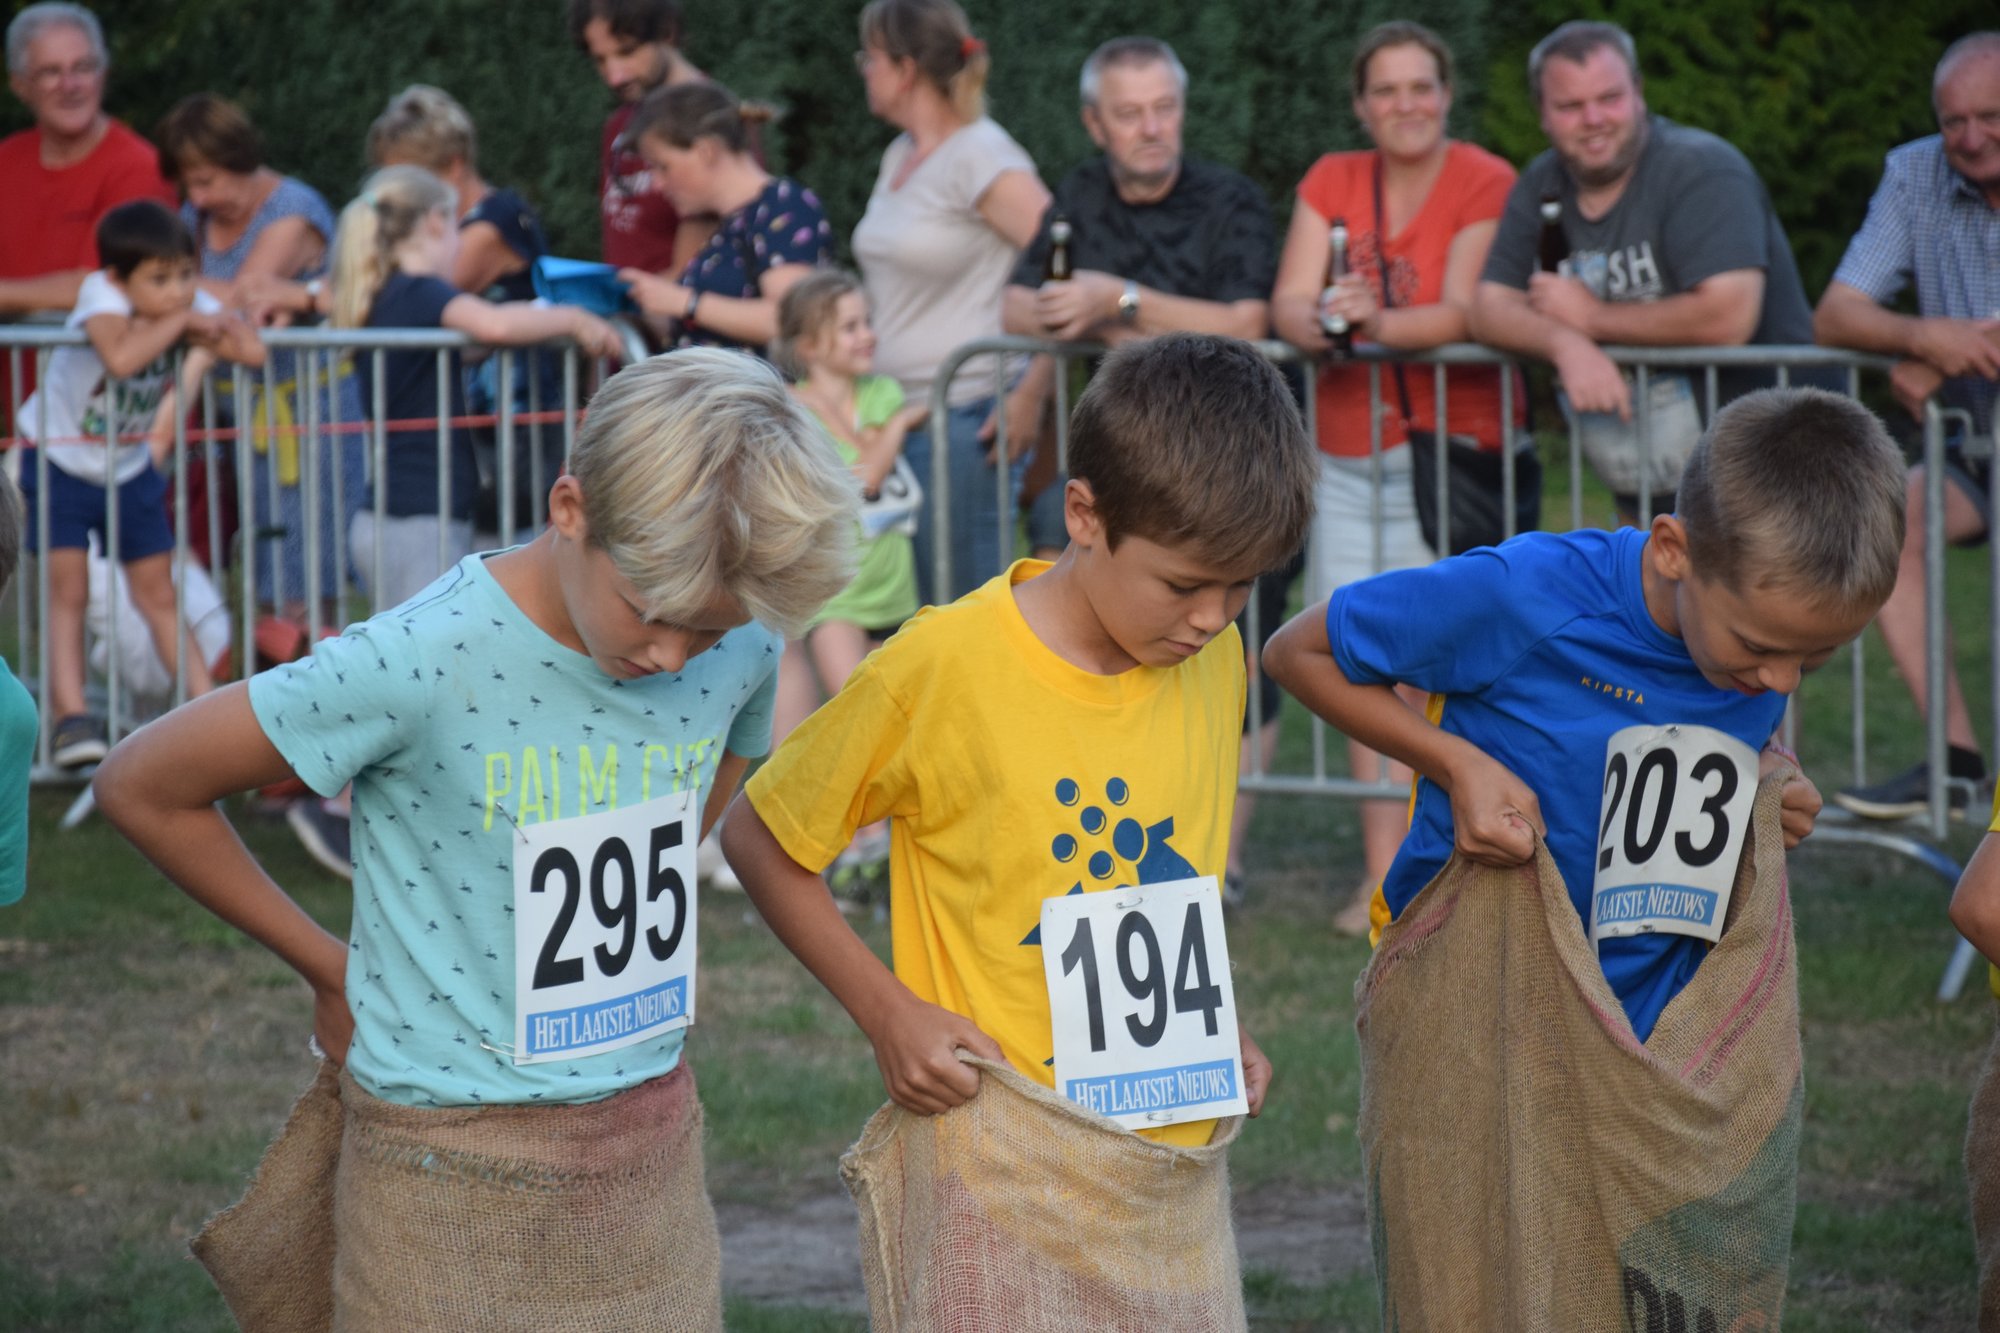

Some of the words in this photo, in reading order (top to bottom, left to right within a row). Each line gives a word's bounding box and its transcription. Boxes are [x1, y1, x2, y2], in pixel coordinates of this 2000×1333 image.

[1581, 676, 1644, 705] KIPSTA
[484, 744, 617, 832] PALM
[1599, 747, 1738, 873] 203
[530, 820, 687, 990] 295
[1645, 886, 1708, 921] NIEUWS
[1061, 902, 1223, 1053] 194
[534, 1015, 568, 1050] HET
[570, 1001, 633, 1045] LAATSTE
[633, 986, 680, 1029] NIEUWS
[1075, 1083, 1108, 1113] HET
[1110, 1076, 1176, 1112] LAATSTE
[1175, 1068, 1230, 1104] NIEUWS
